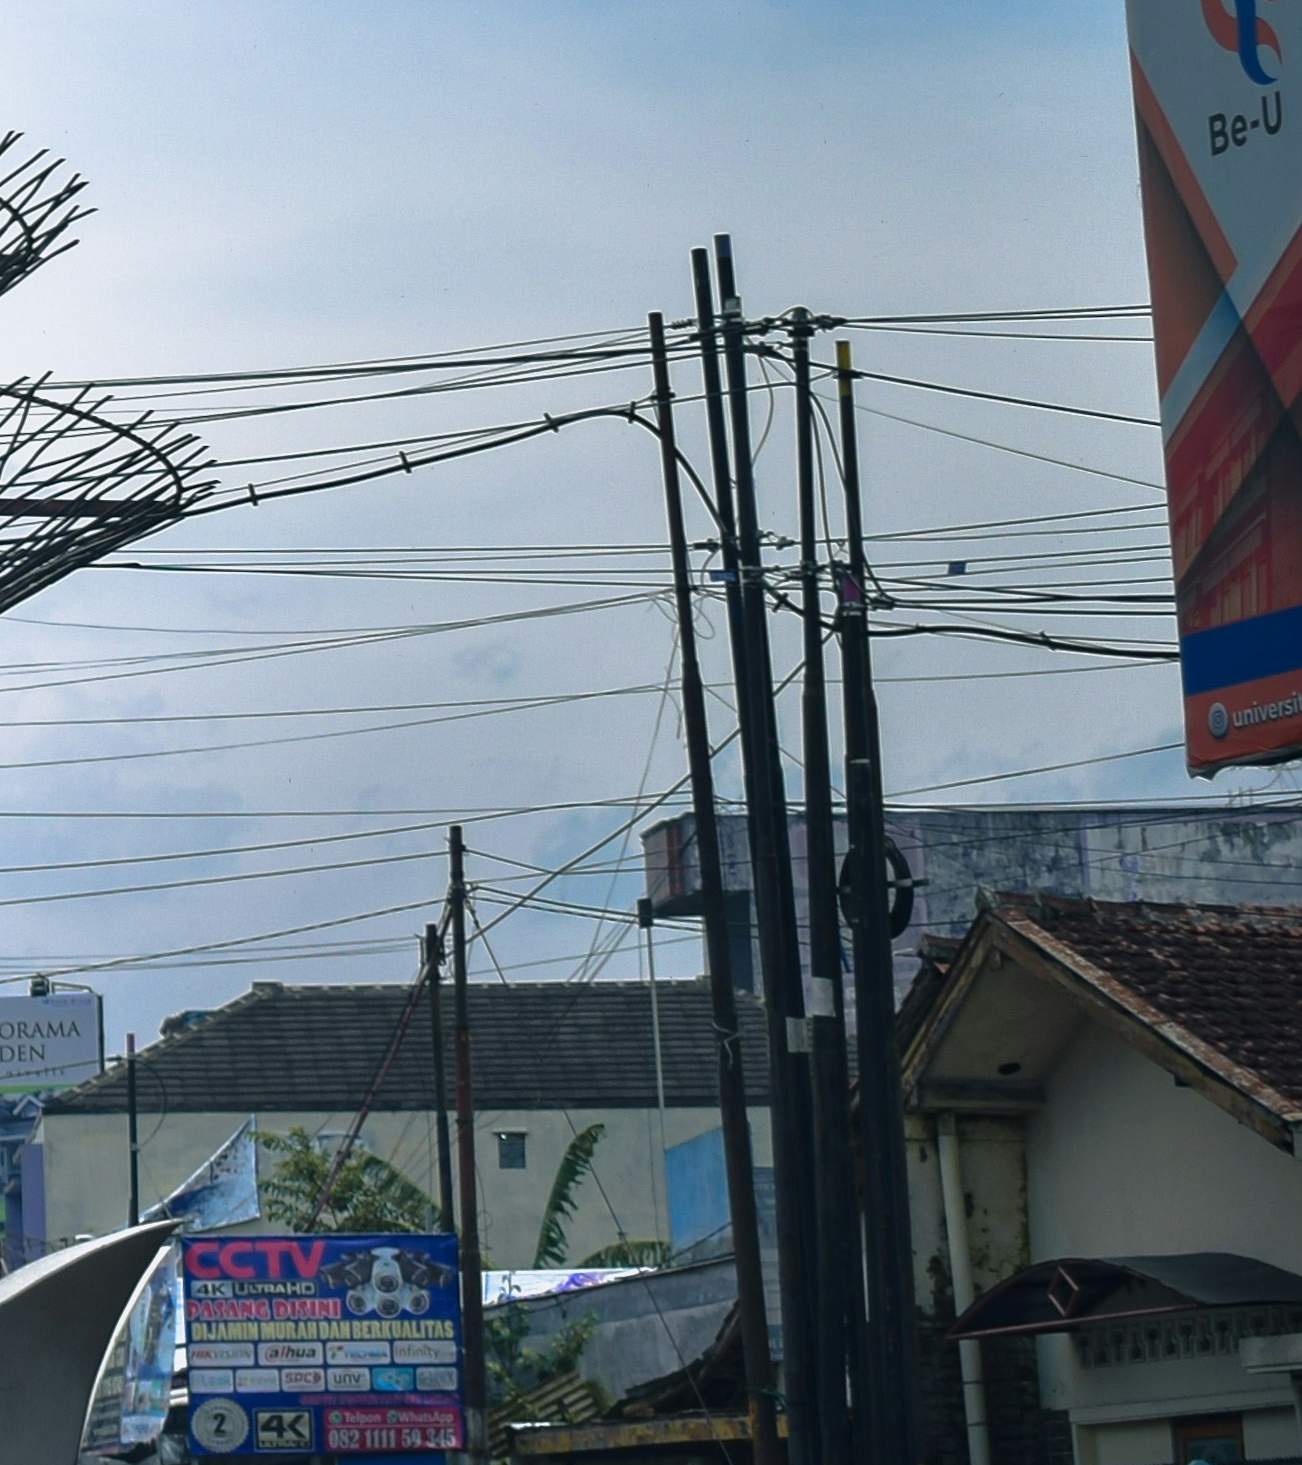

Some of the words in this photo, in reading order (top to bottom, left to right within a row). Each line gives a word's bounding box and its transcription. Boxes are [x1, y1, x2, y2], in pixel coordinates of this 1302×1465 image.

[1208, 90, 1282, 157] Be-U
[185, 1240, 327, 1279] CCTV
[196, 1281, 227, 1296] 4K
[186, 1298, 269, 1321] PASANG
[273, 1298, 341, 1320] DISINI
[192, 1321, 259, 1342] DIJAMIN
[260, 1320, 319, 1341] MURAH
[319, 1320, 352, 1340] DAN
[353, 1319, 454, 1340] BERKUALITAS
[212, 1412, 227, 1436] 2
[260, 1414, 306, 1439] 4K
[343, 1411, 382, 1424] Telpon
[398, 1410, 453, 1424] WhatsApp
[328, 1429, 360, 1449] 082
[365, 1428, 396, 1449] 1111
[401, 1428, 422, 1448] 59
